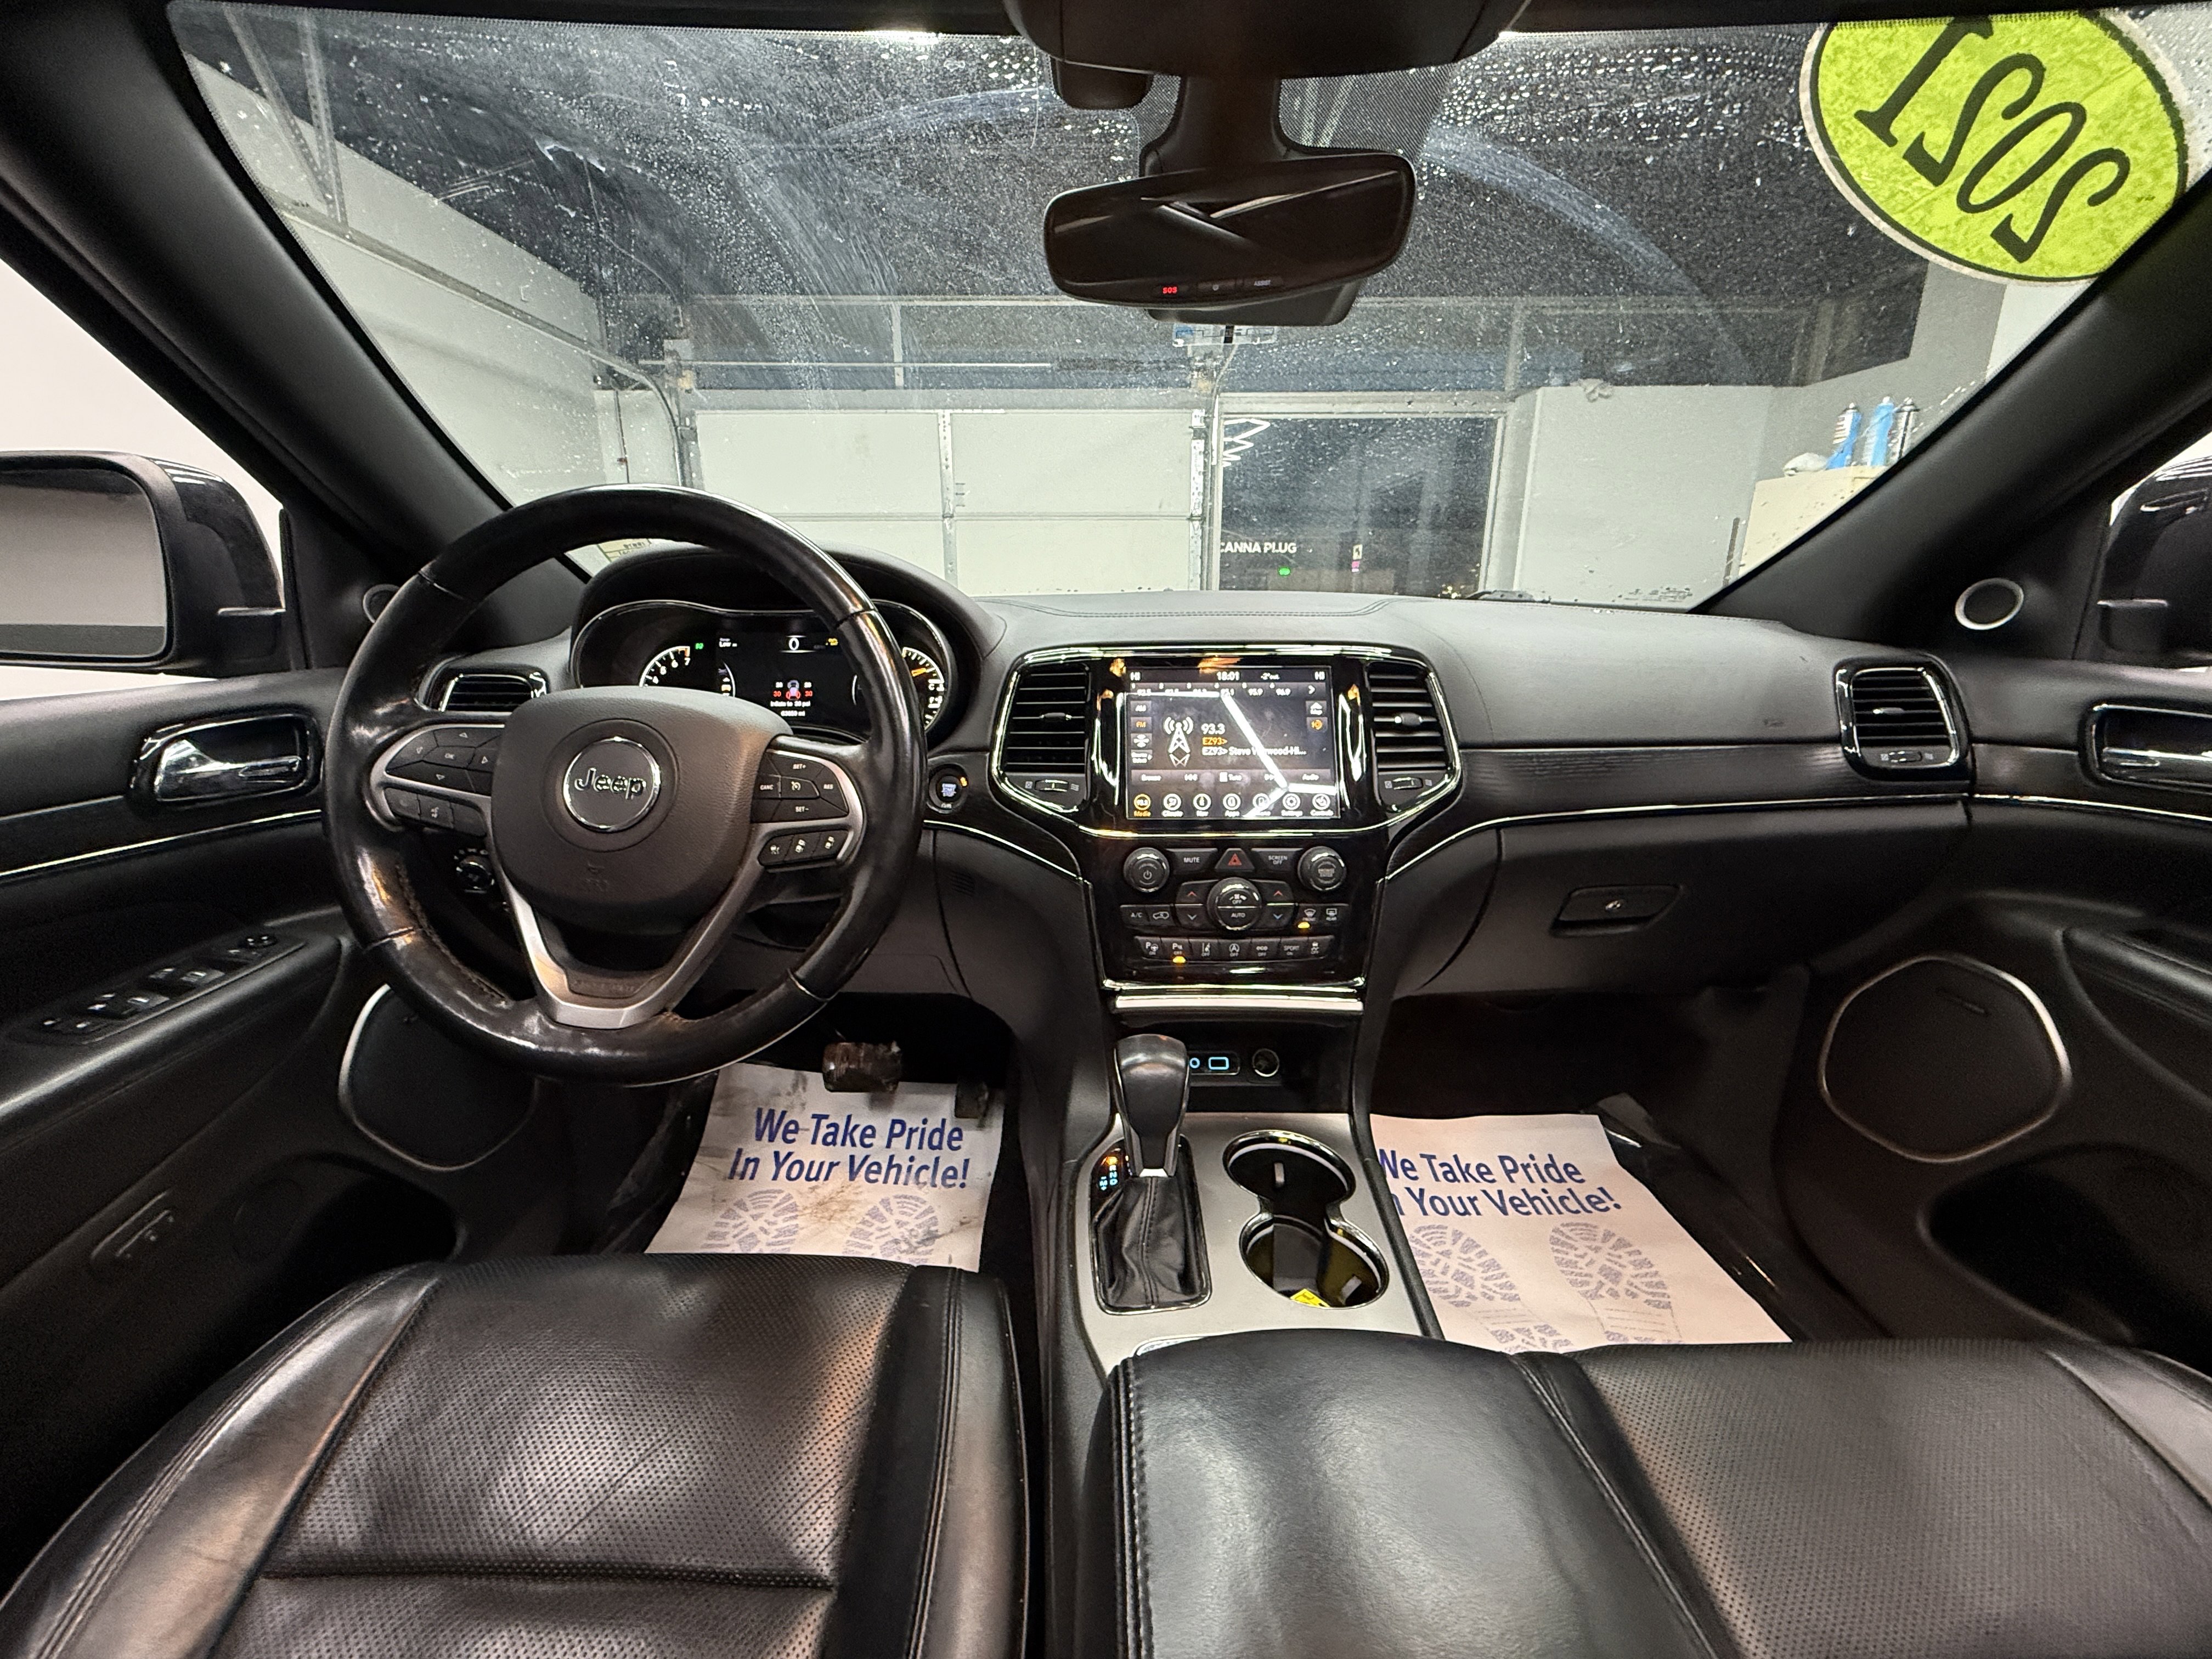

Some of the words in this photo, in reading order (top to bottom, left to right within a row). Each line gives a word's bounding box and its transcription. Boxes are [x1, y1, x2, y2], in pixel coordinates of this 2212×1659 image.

[1263, 541, 1297, 554] PLUG
[788, 637, 799, 651] 0
[671, 659, 679, 668] 6
[684, 657, 691, 665] 7
[1216, 671, 1240, 681] 18:01
[1201, 723, 1226, 735] 93.3
[574, 767, 647, 800] Jeep
[754, 1107, 799, 1144] We
[809, 1113, 877, 1149] Take
[885, 1118, 963, 1152] Pride
[727, 1148, 760, 1181] In
[771, 1150, 842, 1182] Your
[846, 1154, 970, 1189] Vehicle!
[1419, 1153, 1497, 1184] Take
[1497, 1154, 1586, 1184] Pride
[1404, 1187, 1480, 1217] Your
[1482, 1186, 1623, 1217] Vehicle!
